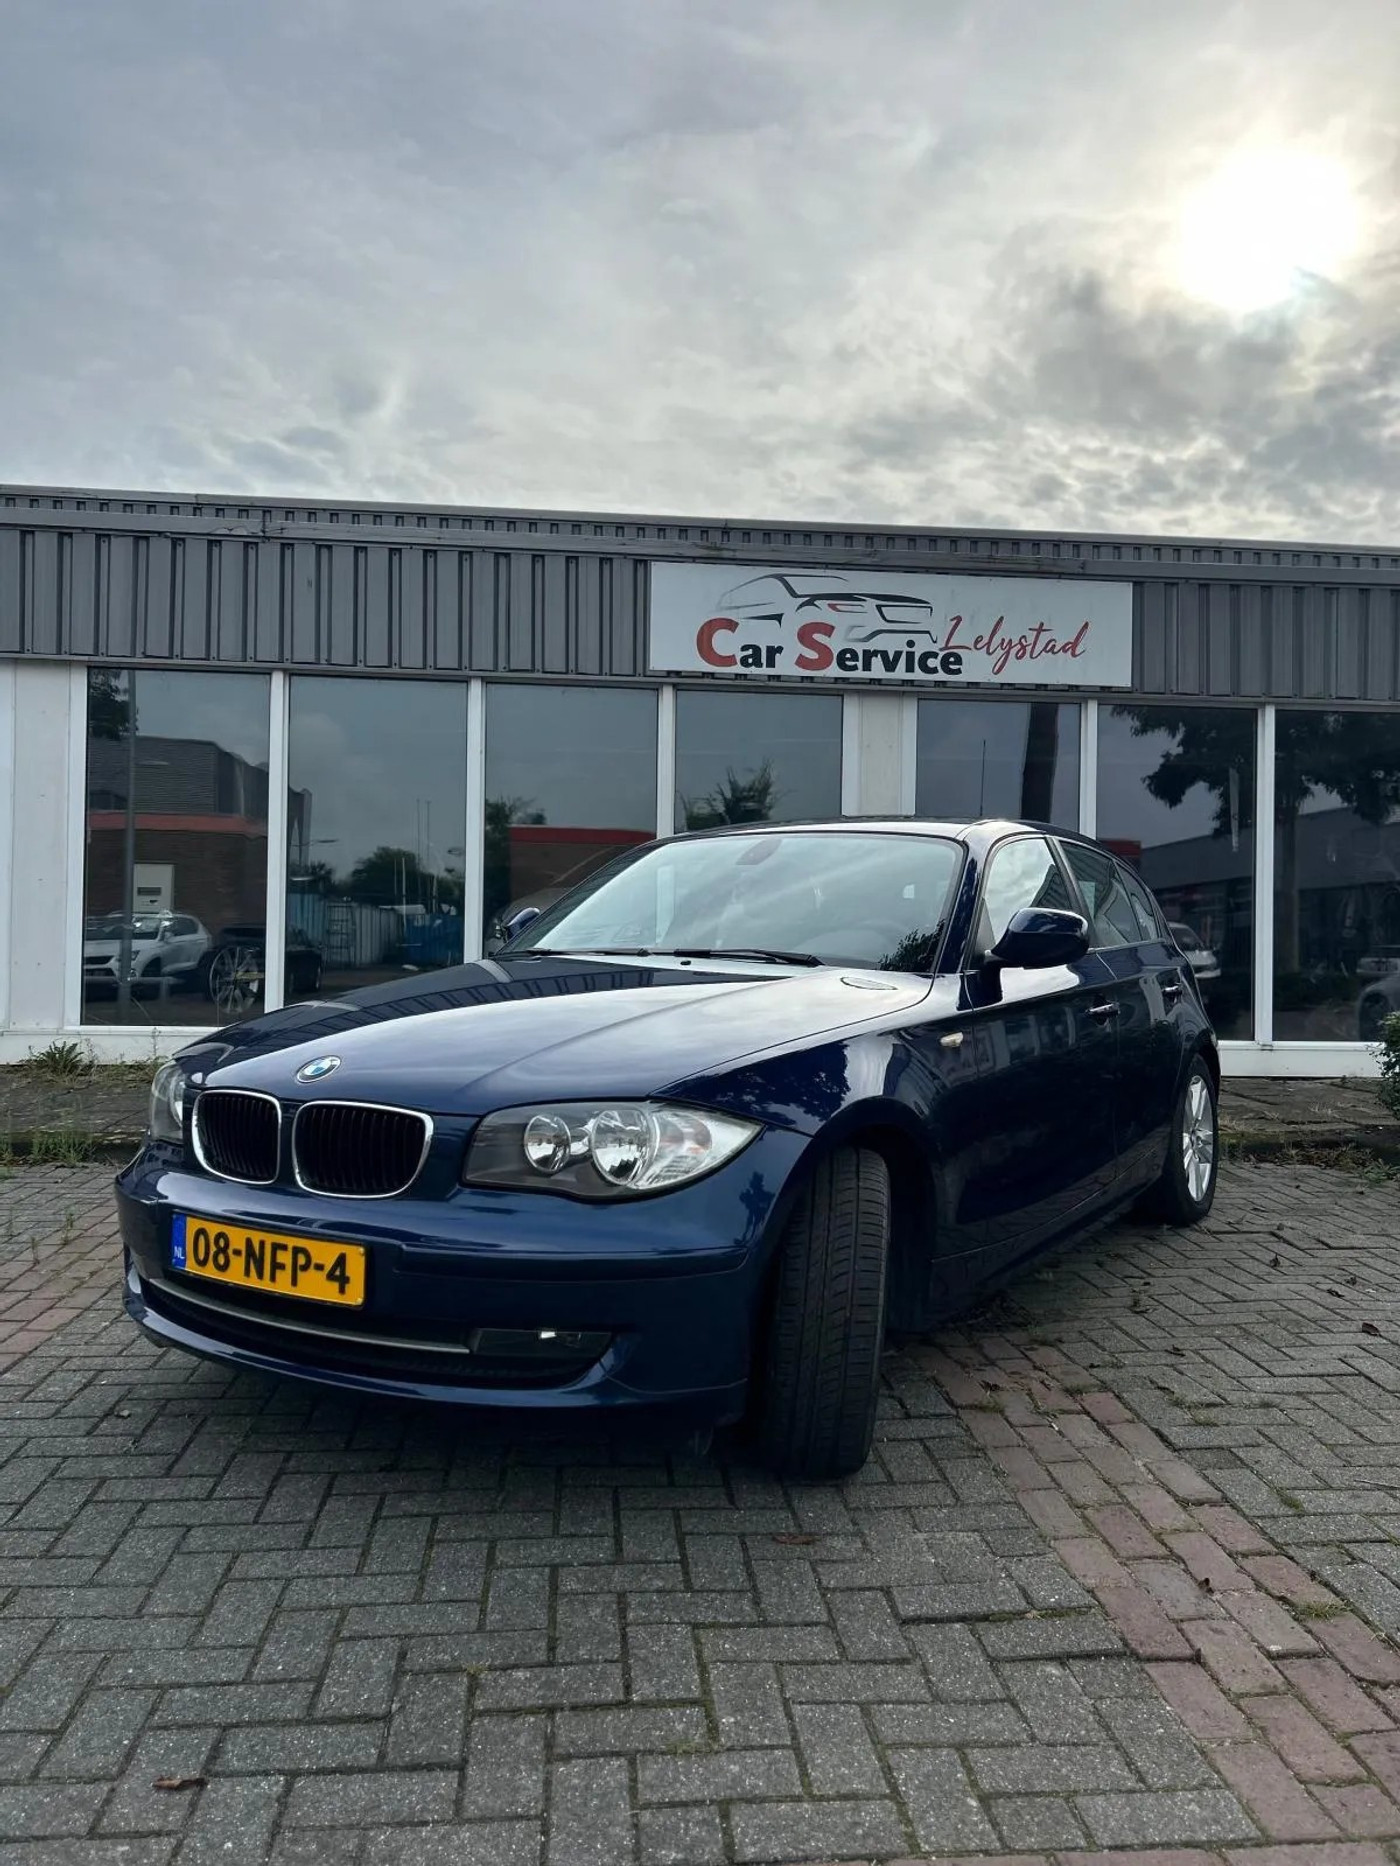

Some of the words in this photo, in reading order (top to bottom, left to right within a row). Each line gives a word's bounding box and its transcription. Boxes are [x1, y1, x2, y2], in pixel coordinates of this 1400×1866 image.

[696, 617, 784, 669] Car
[795, 621, 963, 676] Service
[939, 615, 1091, 675] Lelystad
[173, 1246, 186, 1260] NL
[192, 1227, 350, 1296] 08-NFP-4
